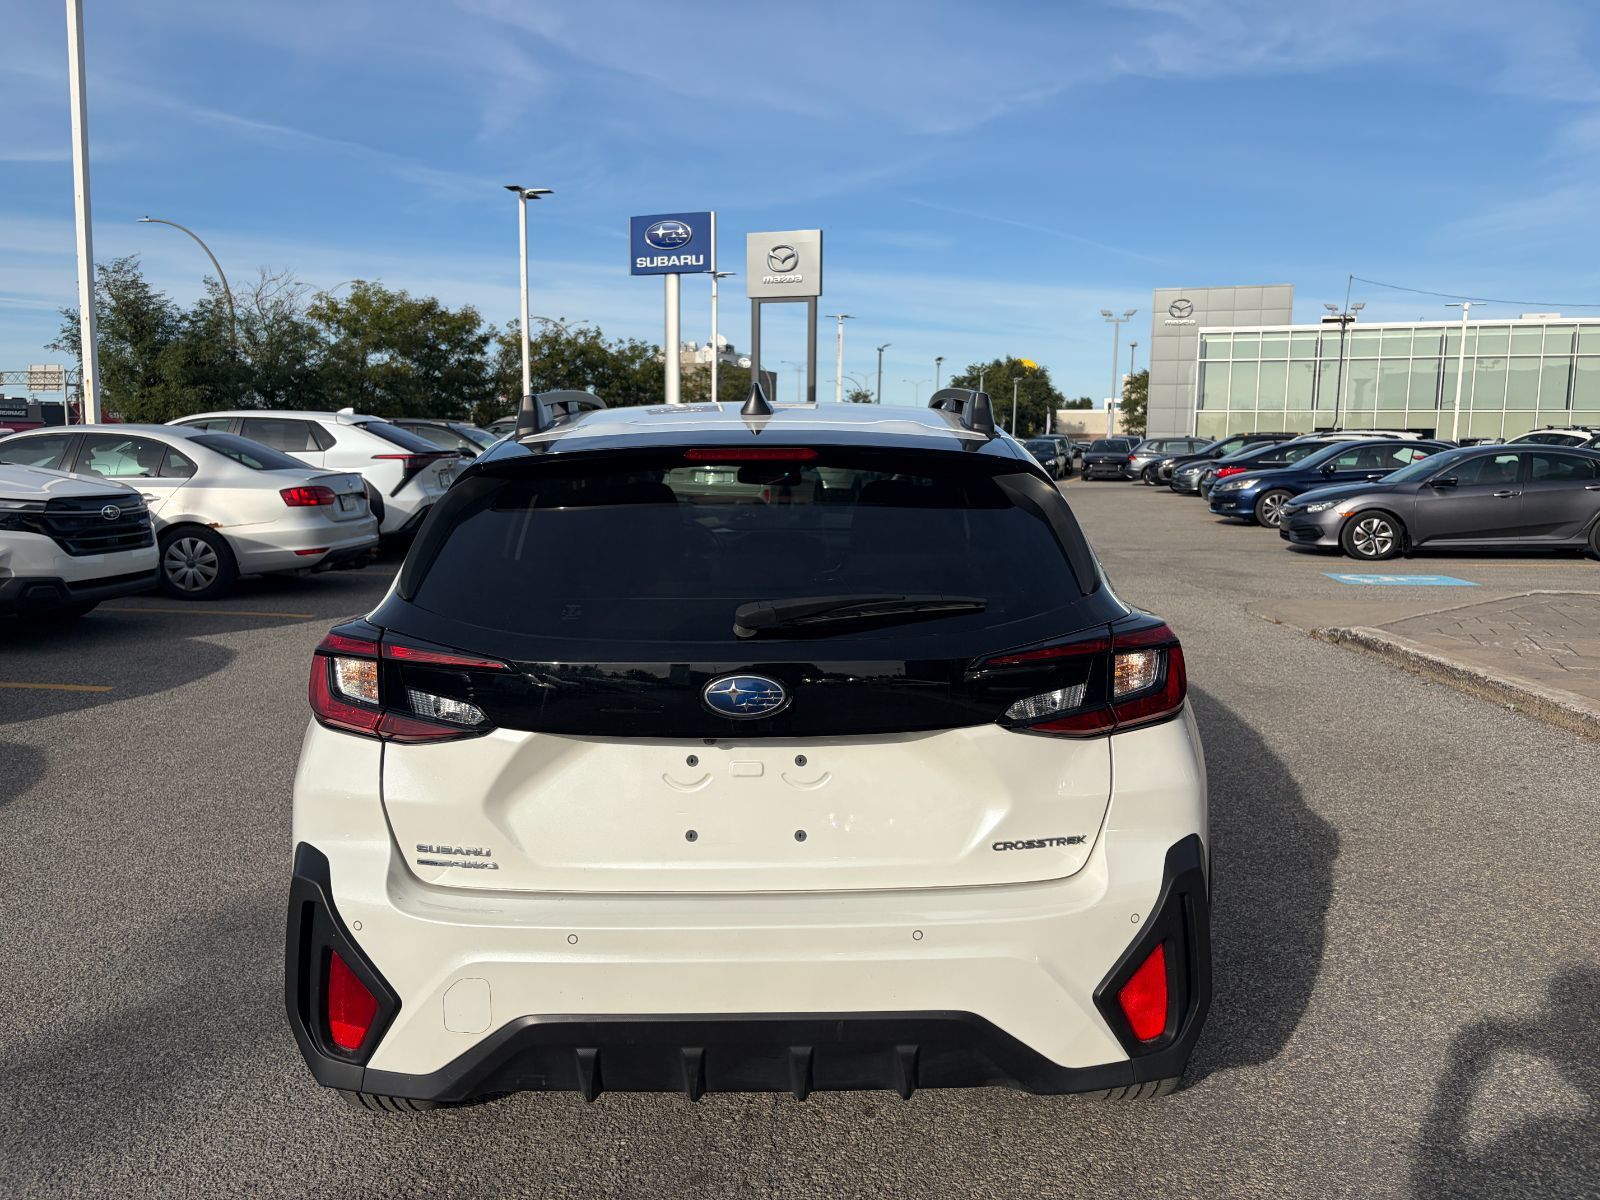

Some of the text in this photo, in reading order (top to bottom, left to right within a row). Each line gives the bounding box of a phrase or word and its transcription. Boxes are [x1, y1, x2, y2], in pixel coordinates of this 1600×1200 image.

[636, 254, 704, 268] SUBARU
[762, 274, 803, 284] mazda
[992, 834, 1087, 851] CROSSTREK
[416, 843, 491, 857] SUBARU
